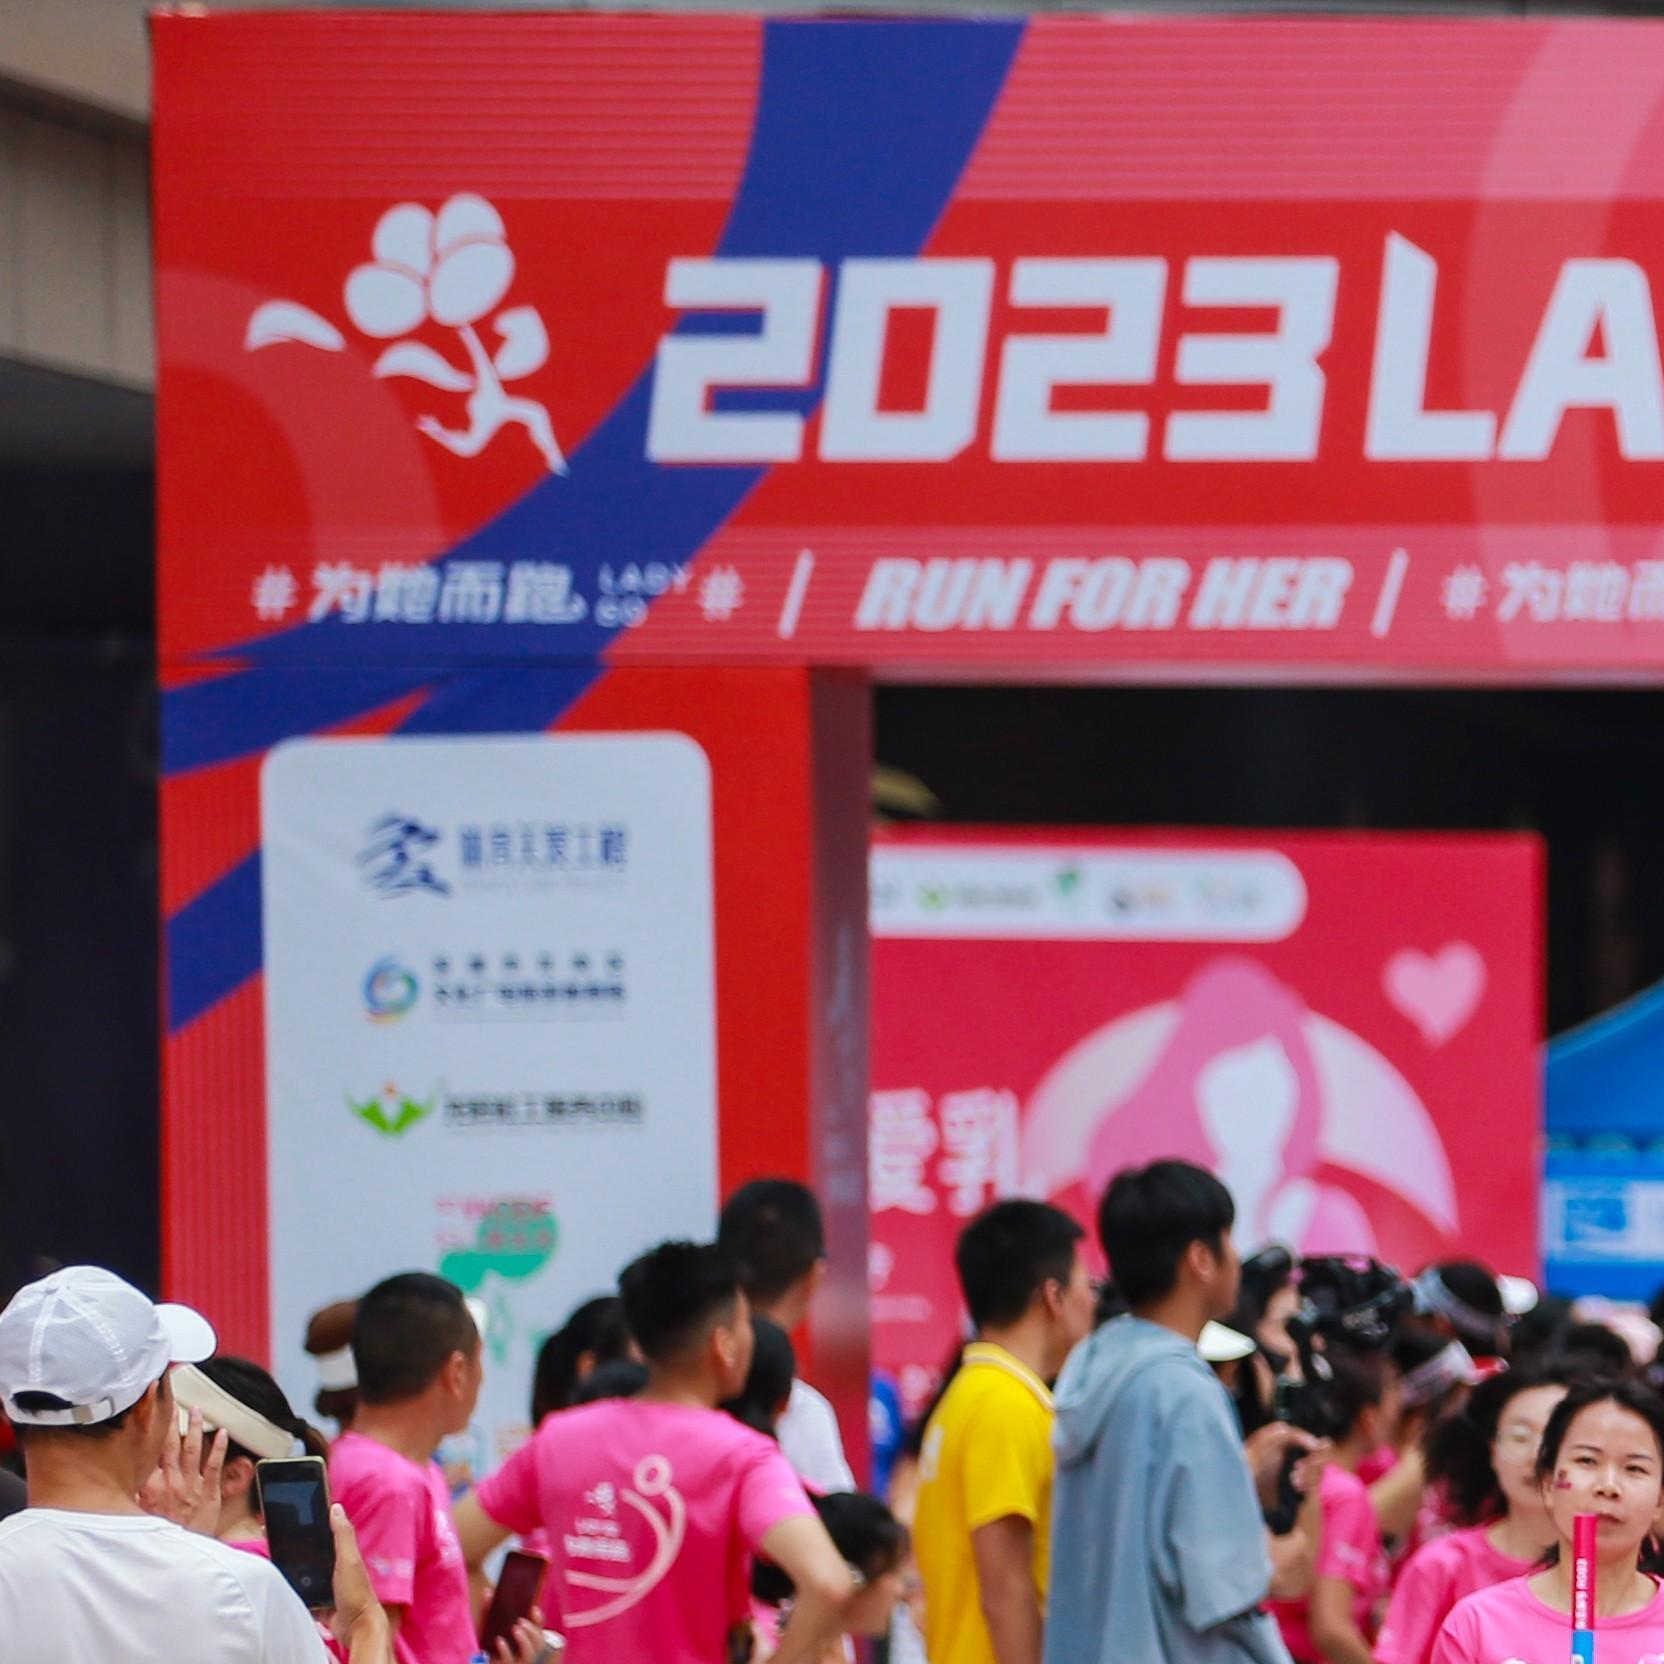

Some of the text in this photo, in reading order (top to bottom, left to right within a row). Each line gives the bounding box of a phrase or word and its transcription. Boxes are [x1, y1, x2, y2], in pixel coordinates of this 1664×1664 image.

[646, 257, 1340, 462] 2023
[854, 557, 1354, 631] RUN FOR HER
